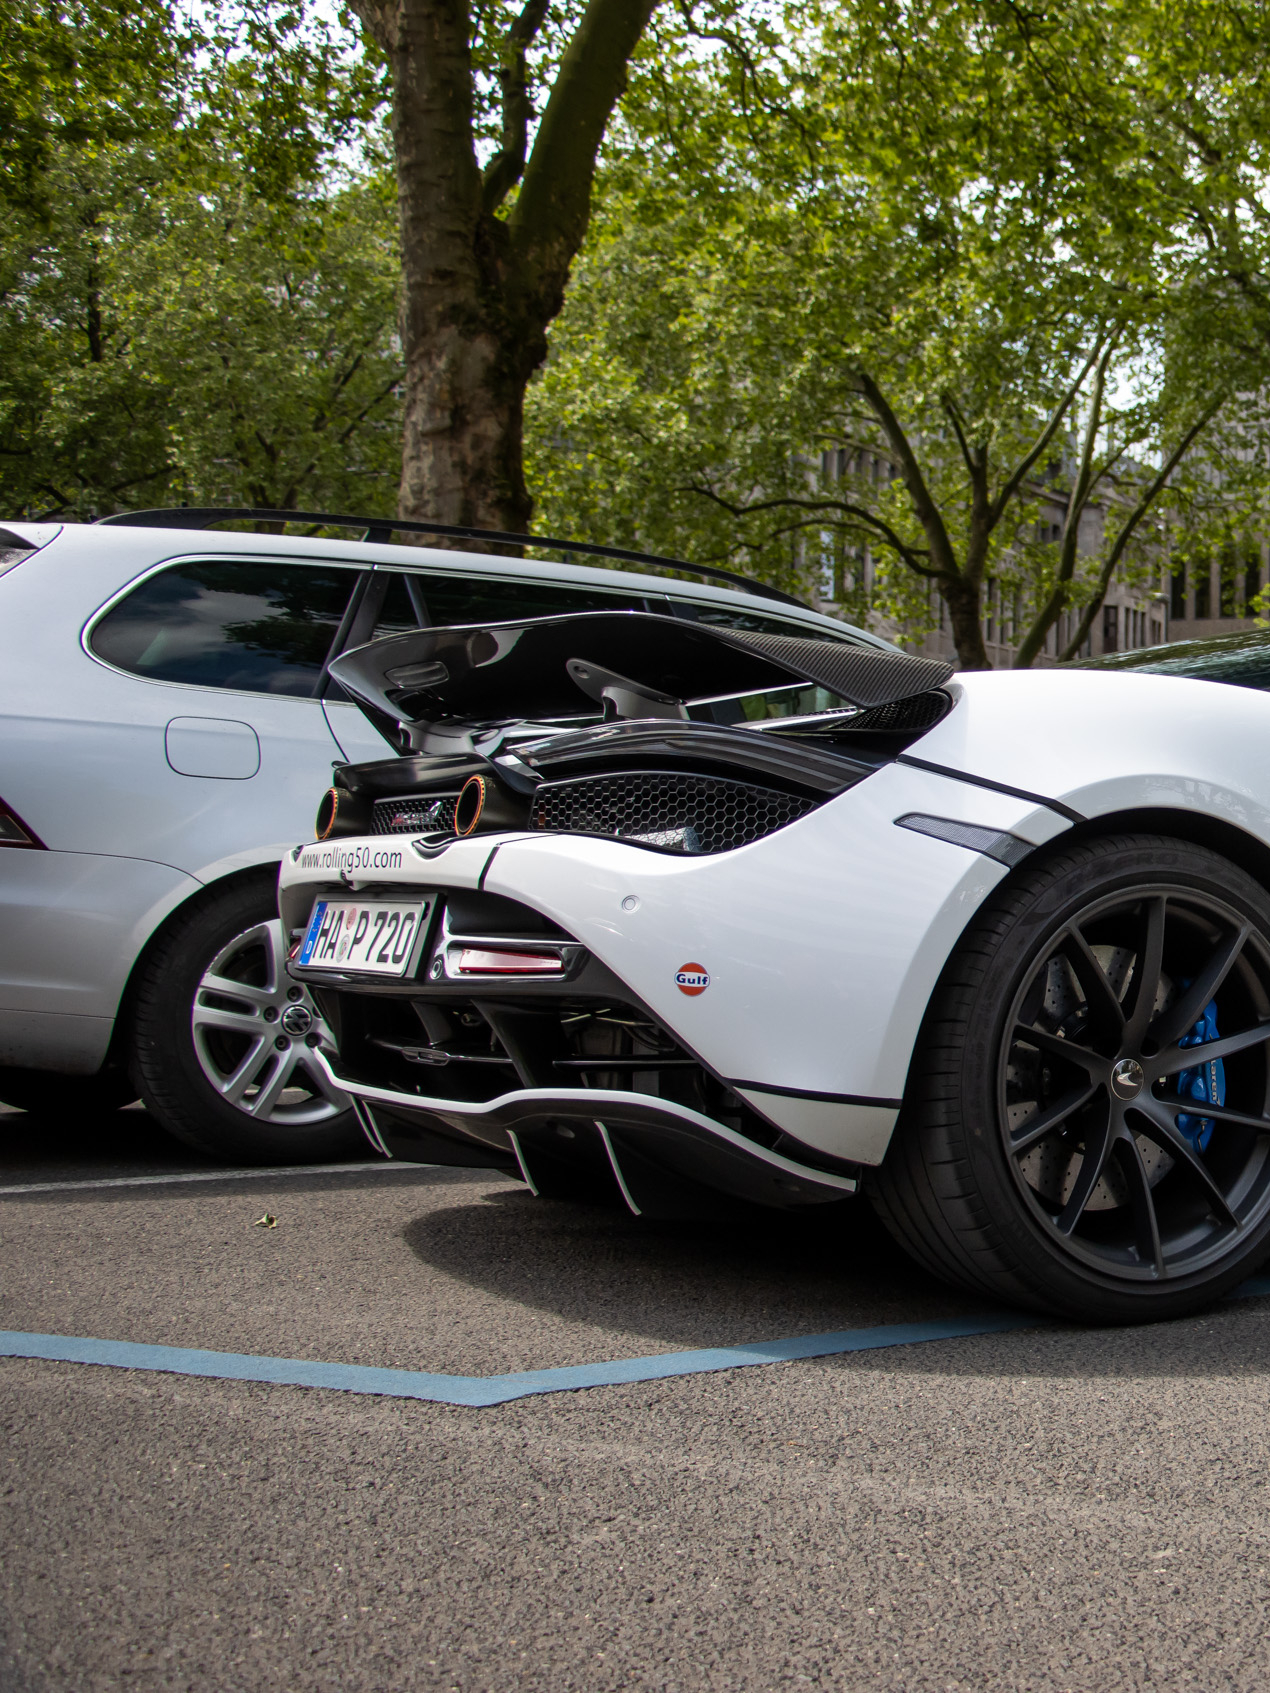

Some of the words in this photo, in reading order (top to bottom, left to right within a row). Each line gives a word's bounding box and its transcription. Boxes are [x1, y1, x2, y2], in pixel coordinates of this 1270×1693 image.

[301, 847, 402, 873] www.rolling50.com
[305, 940, 313, 954] D
[312, 910, 345, 959] HA
[347, 910, 370, 960] P
[365, 911, 417, 964] 720
[676, 973, 709, 985] Gulf
